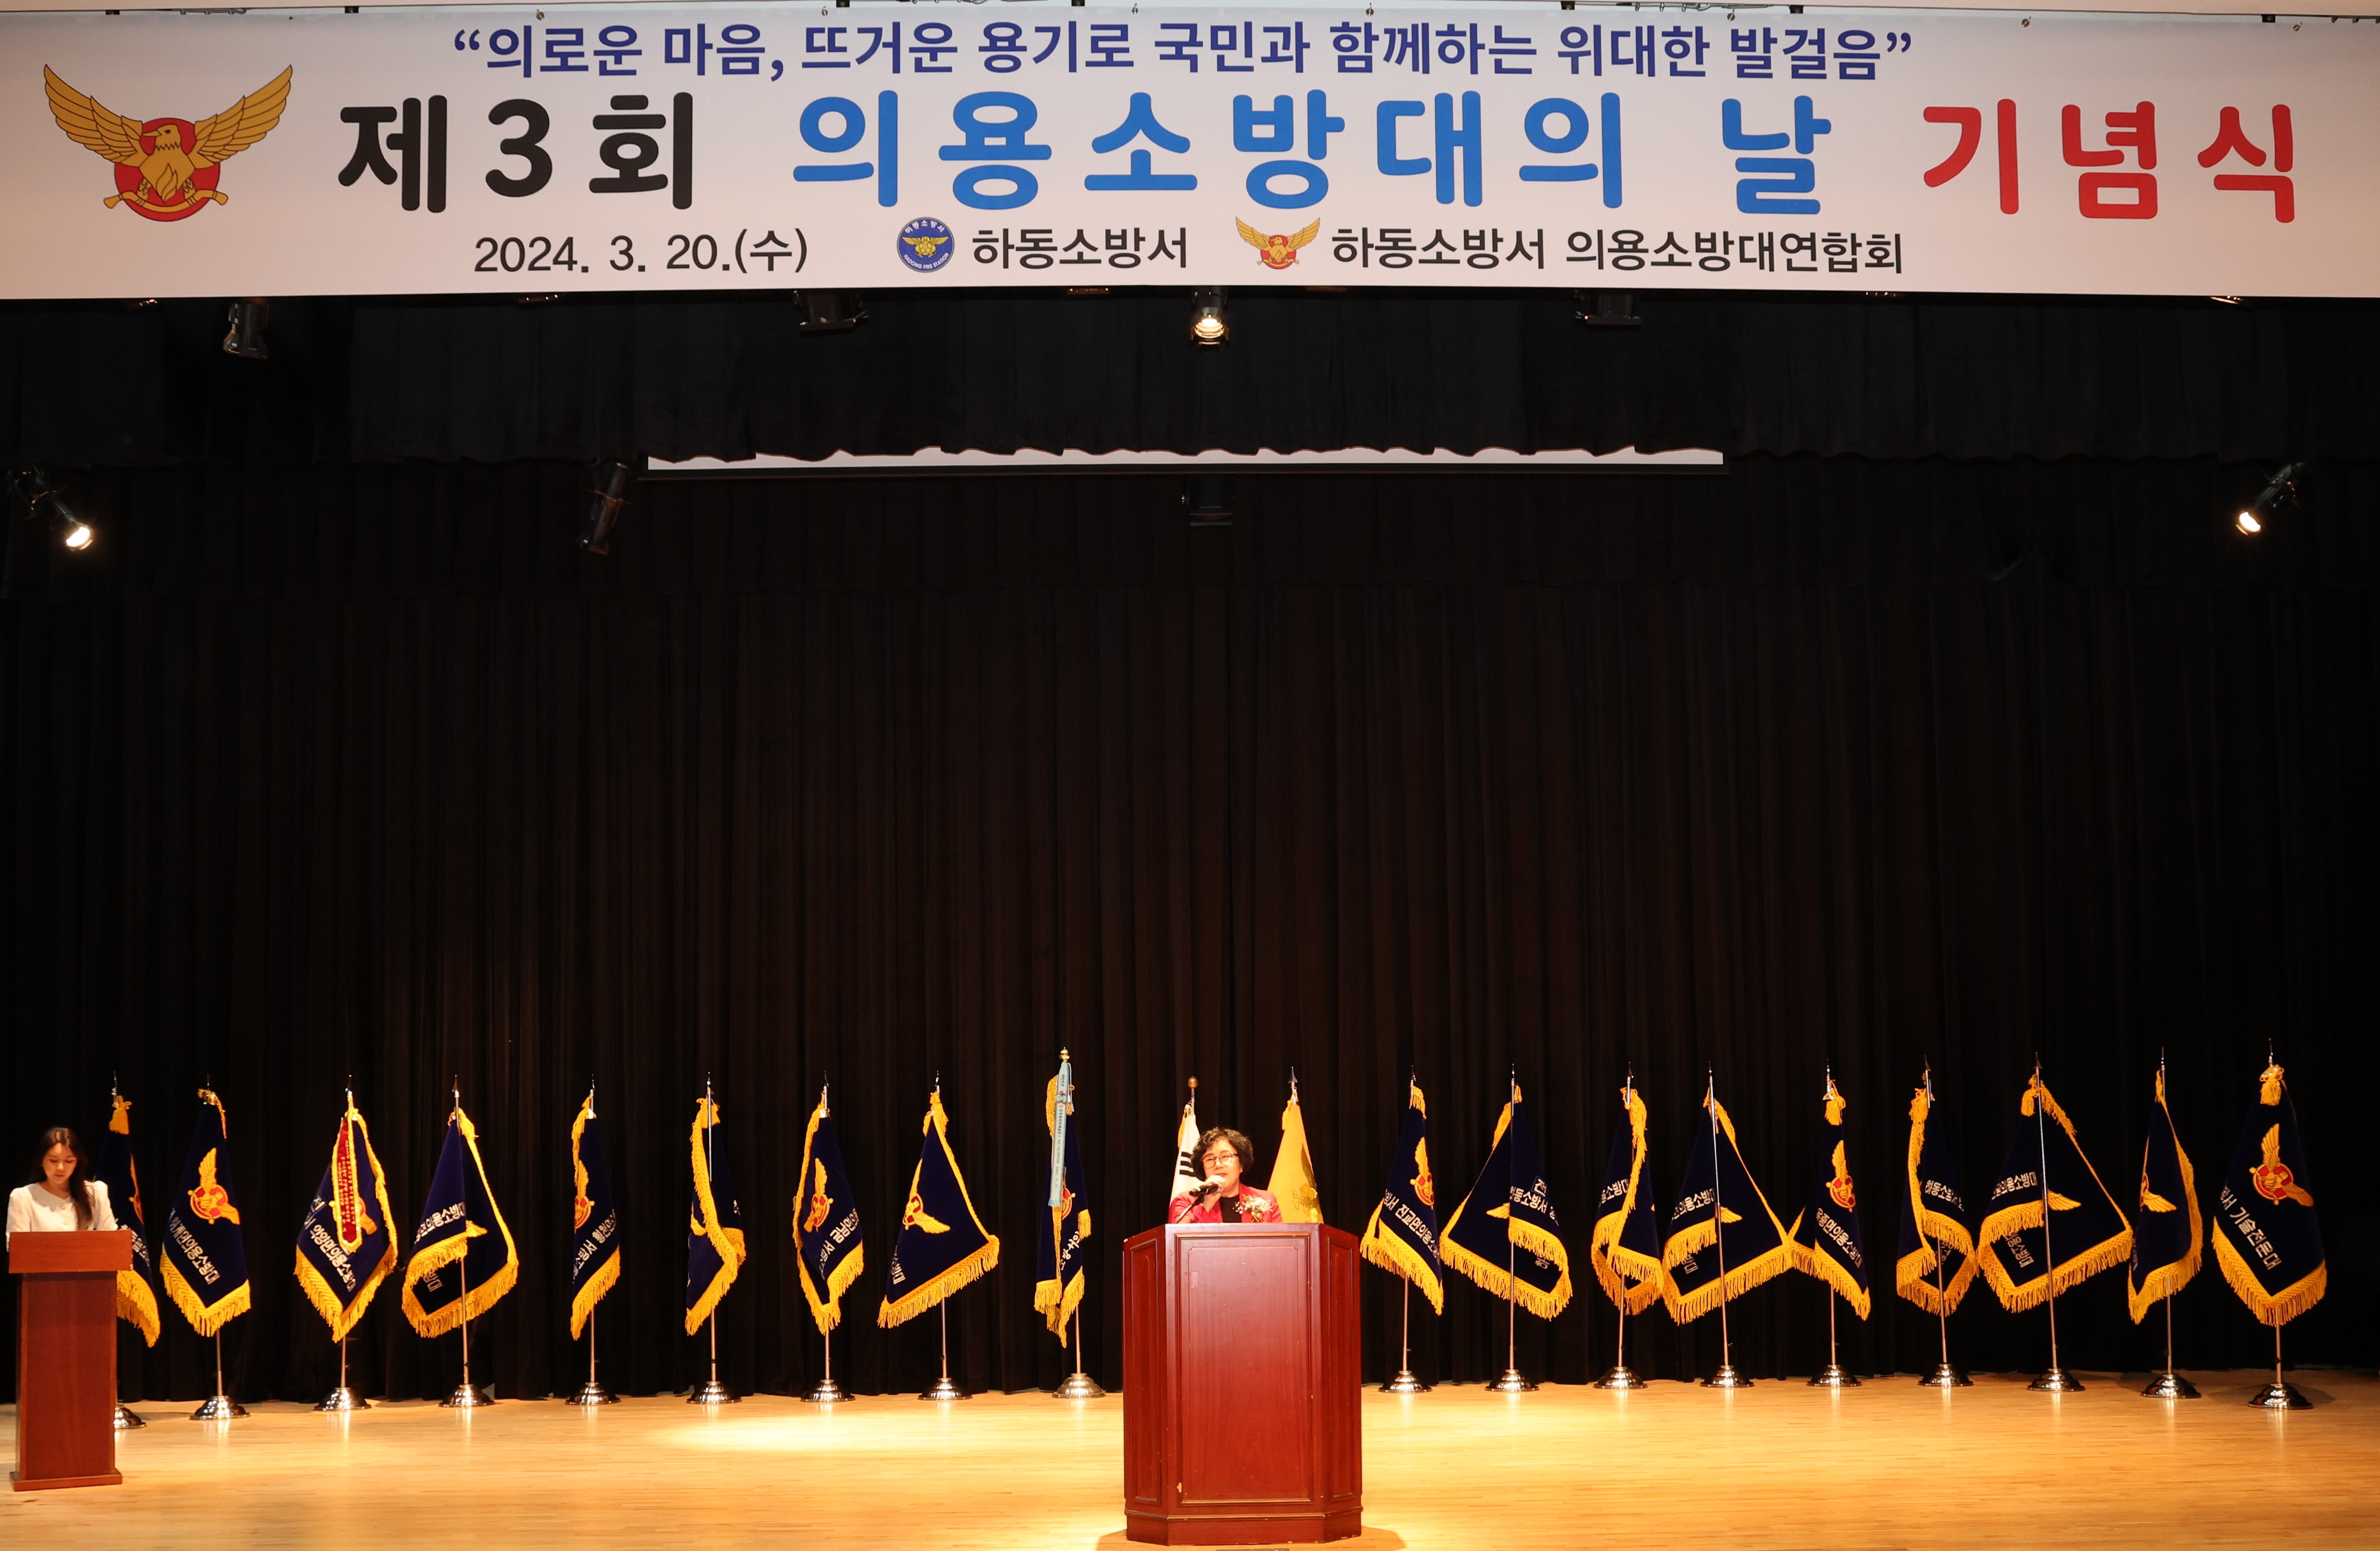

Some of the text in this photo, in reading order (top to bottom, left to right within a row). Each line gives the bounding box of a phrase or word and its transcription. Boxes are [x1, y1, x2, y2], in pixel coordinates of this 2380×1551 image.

[455, 21, 1911, 81] “의로운 마음, 뜨거운 용기로 국민과 함께하는 위대한 발걸음”
[794, 90, 1621, 209] 의용소방대의
[1723, 96, 1830, 214] 날
[1925, 99, 2295, 222] 기념식
[475, 229, 806, 273] 2024. 3. 20.(수)
[904, 254, 922, 269] HADONG
[933, 252, 949, 268] STATION
[973, 228, 1186, 269] 하동소방서
[1332, 228, 1901, 274] 하동소방서 의용소방대연합회
[309, 1223, 356, 1292] 악양면의용소방대
[2230, 1206, 2282, 1271] 기술전문대
